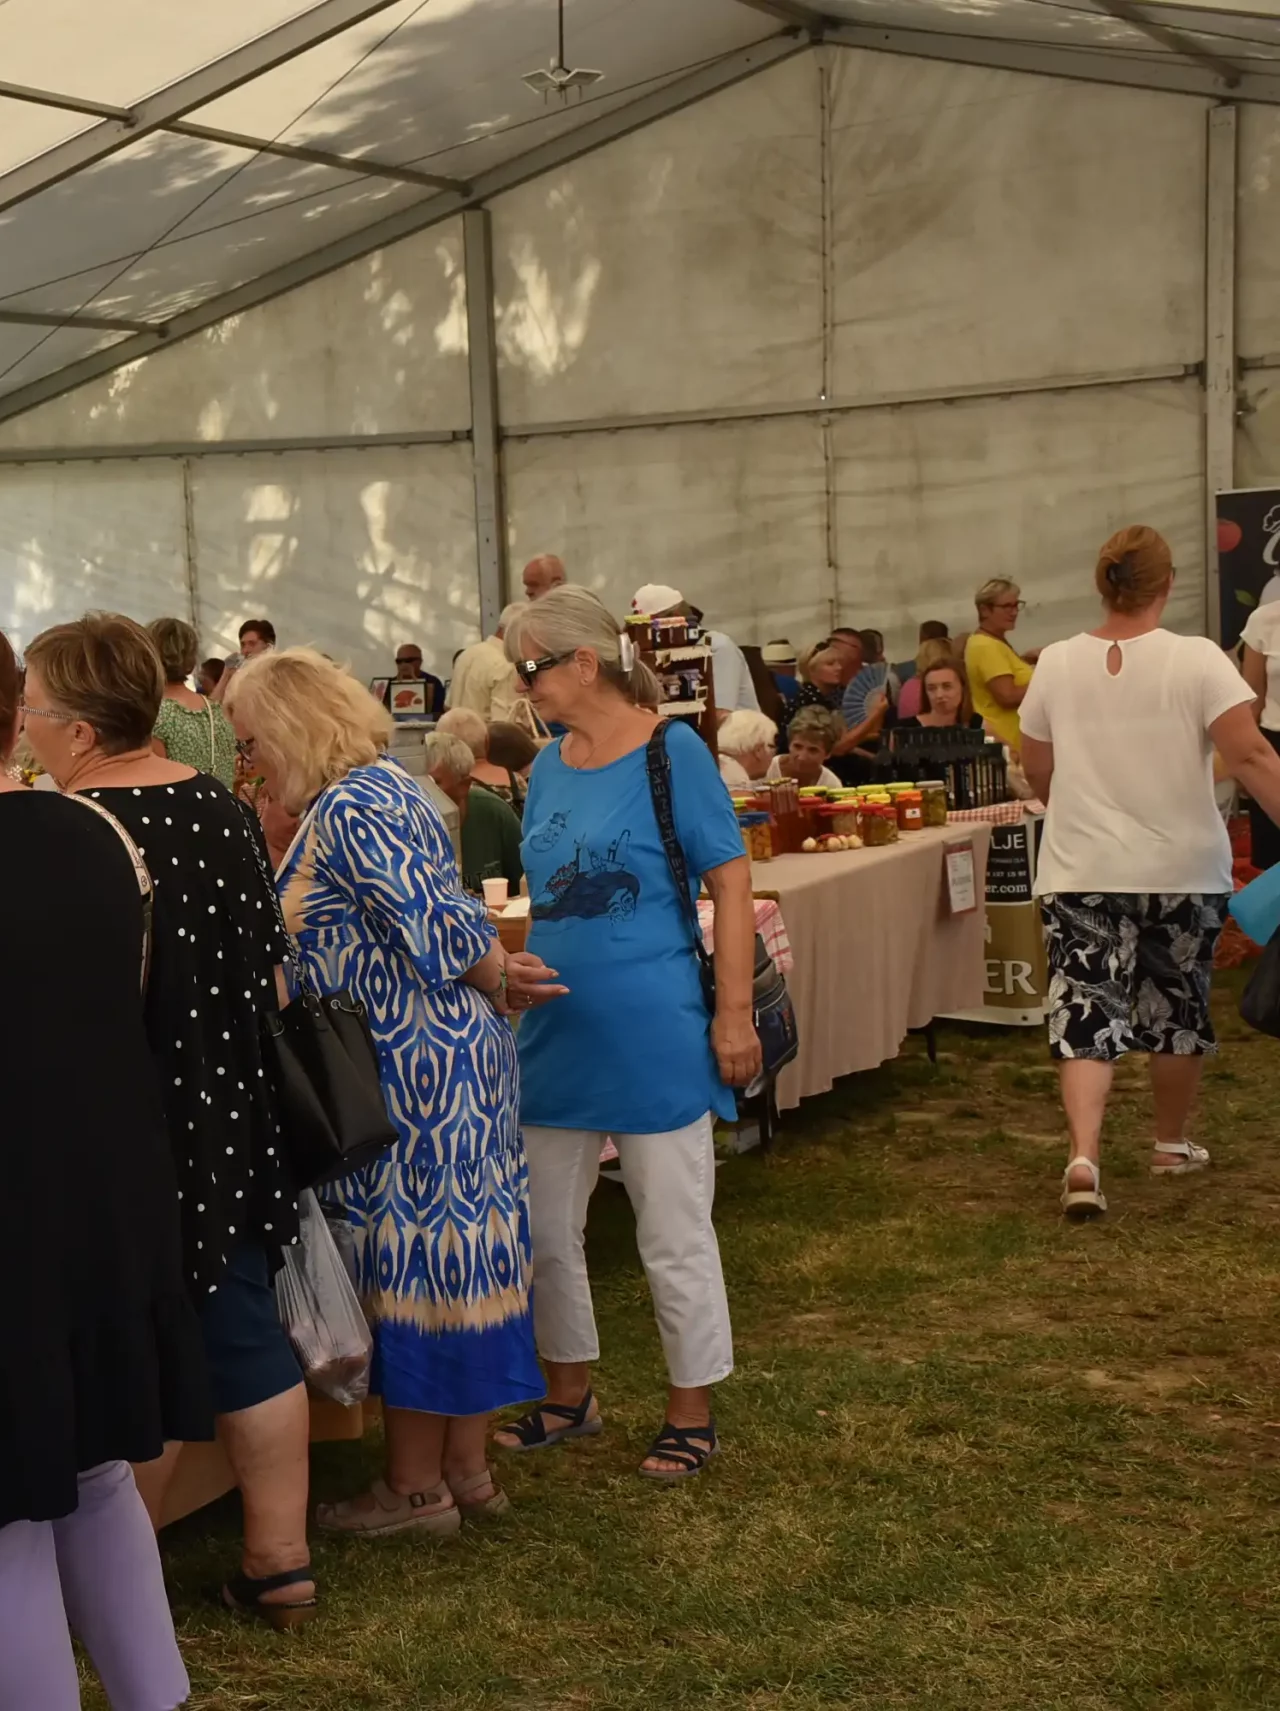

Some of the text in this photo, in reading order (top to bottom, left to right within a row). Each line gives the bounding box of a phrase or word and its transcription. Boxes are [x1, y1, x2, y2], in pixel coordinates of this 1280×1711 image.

[990, 833, 1026, 850] LJE
[985, 884, 1028, 894] er.com
[983, 959, 1037, 995] ER
